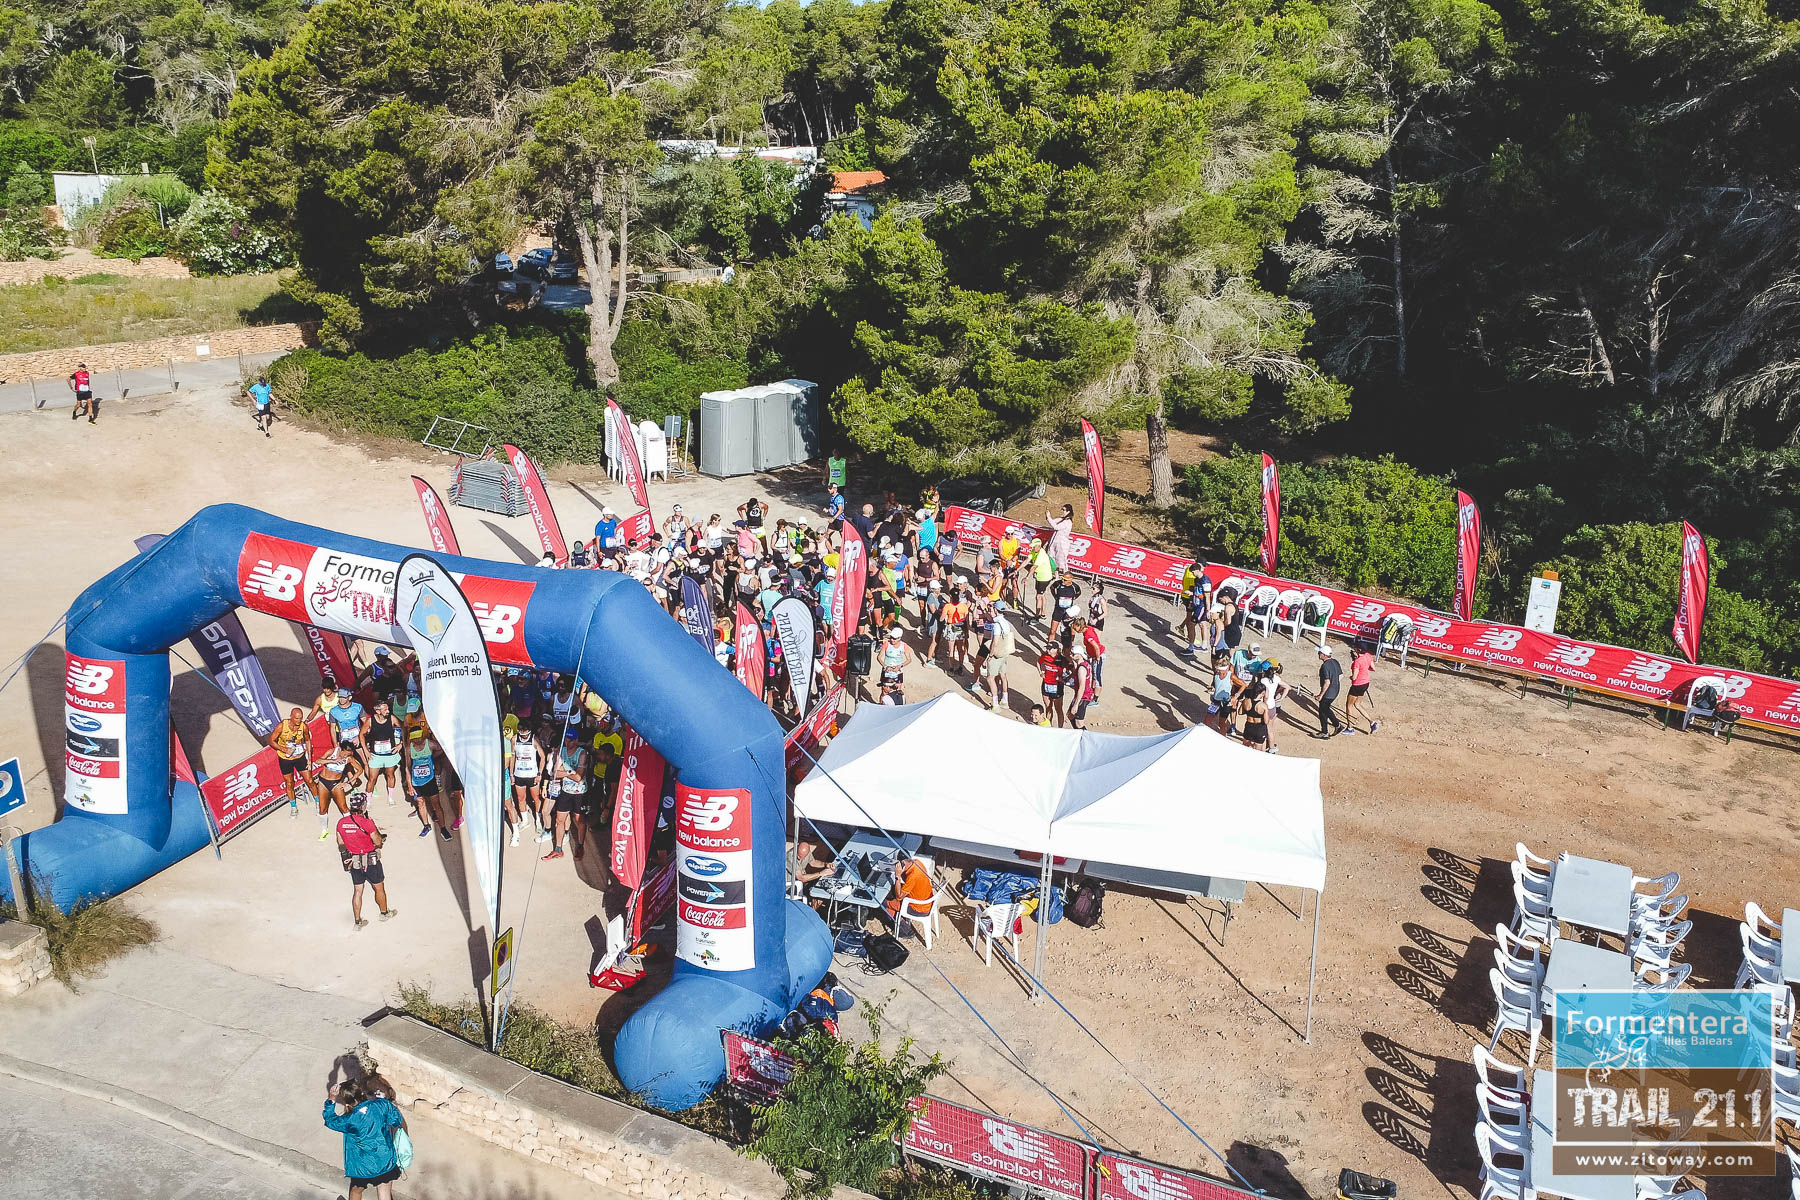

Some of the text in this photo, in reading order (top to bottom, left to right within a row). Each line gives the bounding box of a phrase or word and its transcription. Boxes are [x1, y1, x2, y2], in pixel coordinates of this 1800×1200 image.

[954, 511, 987, 532] NB
[1107, 547, 1147, 569] NB
[244, 559, 303, 602] NB
[1099, 564, 1148, 582] new balance
[1154, 577, 1170, 587] new
[1340, 599, 1386, 623] NB
[1331, 618, 1349, 628] new
[1413, 613, 1452, 638] NB
[1415, 636, 1454, 651] balance
[1473, 627, 1523, 651] NB
[1462, 646, 1524, 665] new balance
[1544, 641, 1596, 667] NB
[66, 659, 114, 695] NB
[1533, 660, 1597, 681] new balance
[1618, 655, 1672, 683] NB
[1606, 677, 1674, 697] new balance
[74, 695, 115, 710] balance
[1765, 709, 1789, 720] new
[222, 763, 260, 811] NB
[219, 788, 273, 828] new balance
[679, 793, 739, 832] NB
[678, 829, 741, 848] new balance
